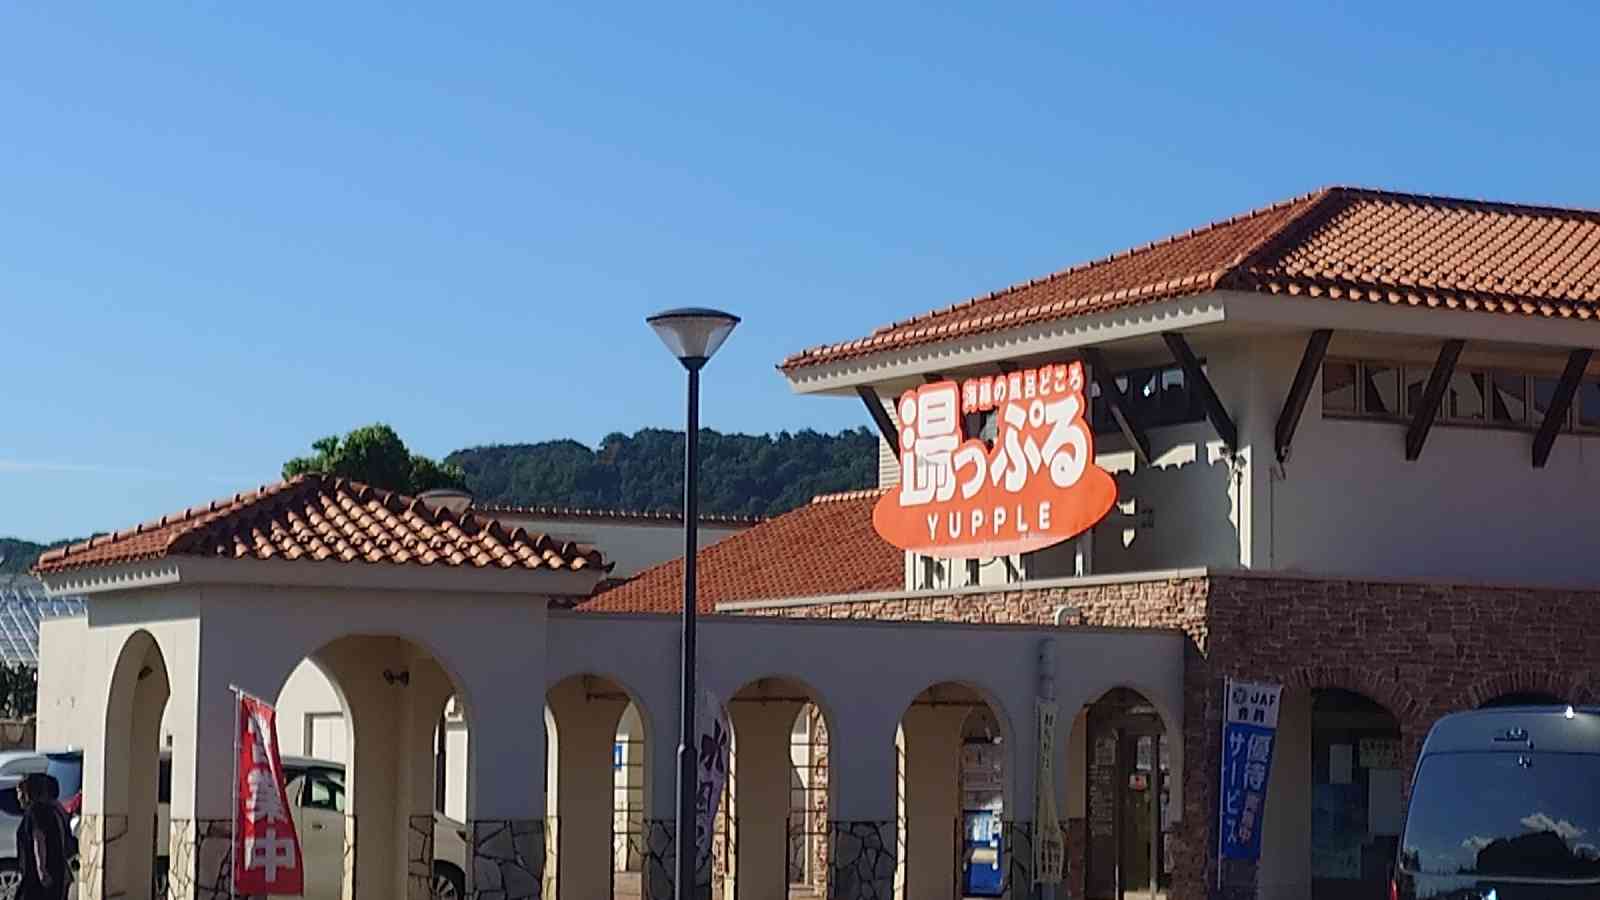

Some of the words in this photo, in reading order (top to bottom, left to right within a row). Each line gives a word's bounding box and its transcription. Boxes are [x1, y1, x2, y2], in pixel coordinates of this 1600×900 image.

[899, 387, 1088, 507] 湯っぷる
[927, 500, 1051, 541] YUPPLE
[1250, 690, 1277, 706] JAF
[1227, 731, 1245, 844] サービス
